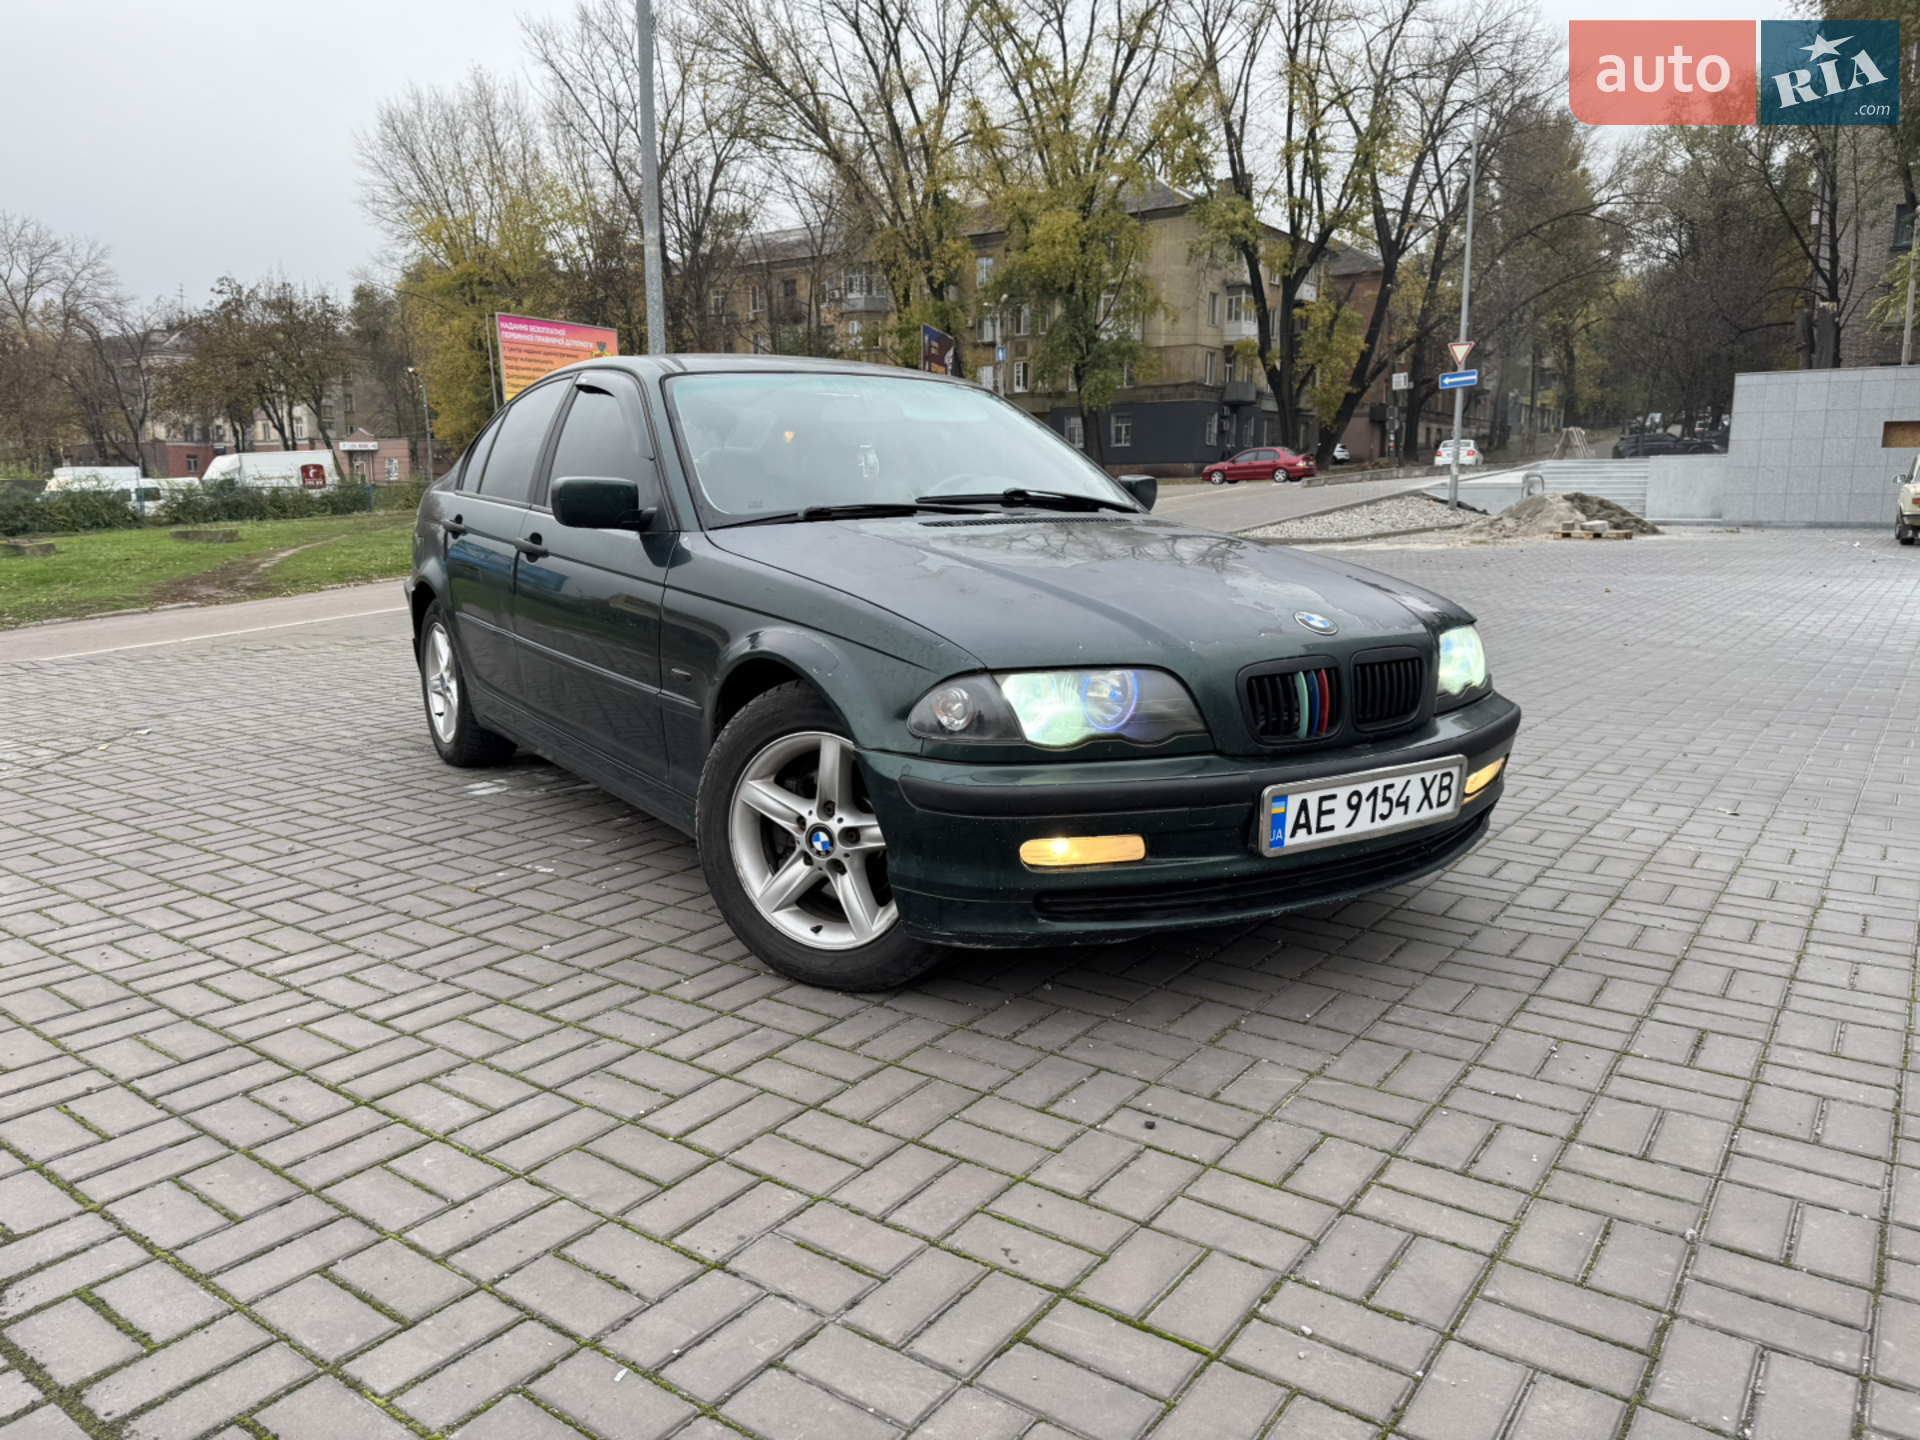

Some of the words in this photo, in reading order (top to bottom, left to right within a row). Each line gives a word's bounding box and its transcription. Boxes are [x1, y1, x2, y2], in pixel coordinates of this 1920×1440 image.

[1289, 794, 1337, 839] AE
[1345, 779, 1411, 829] 9154
[1416, 771, 1454, 814] XB
